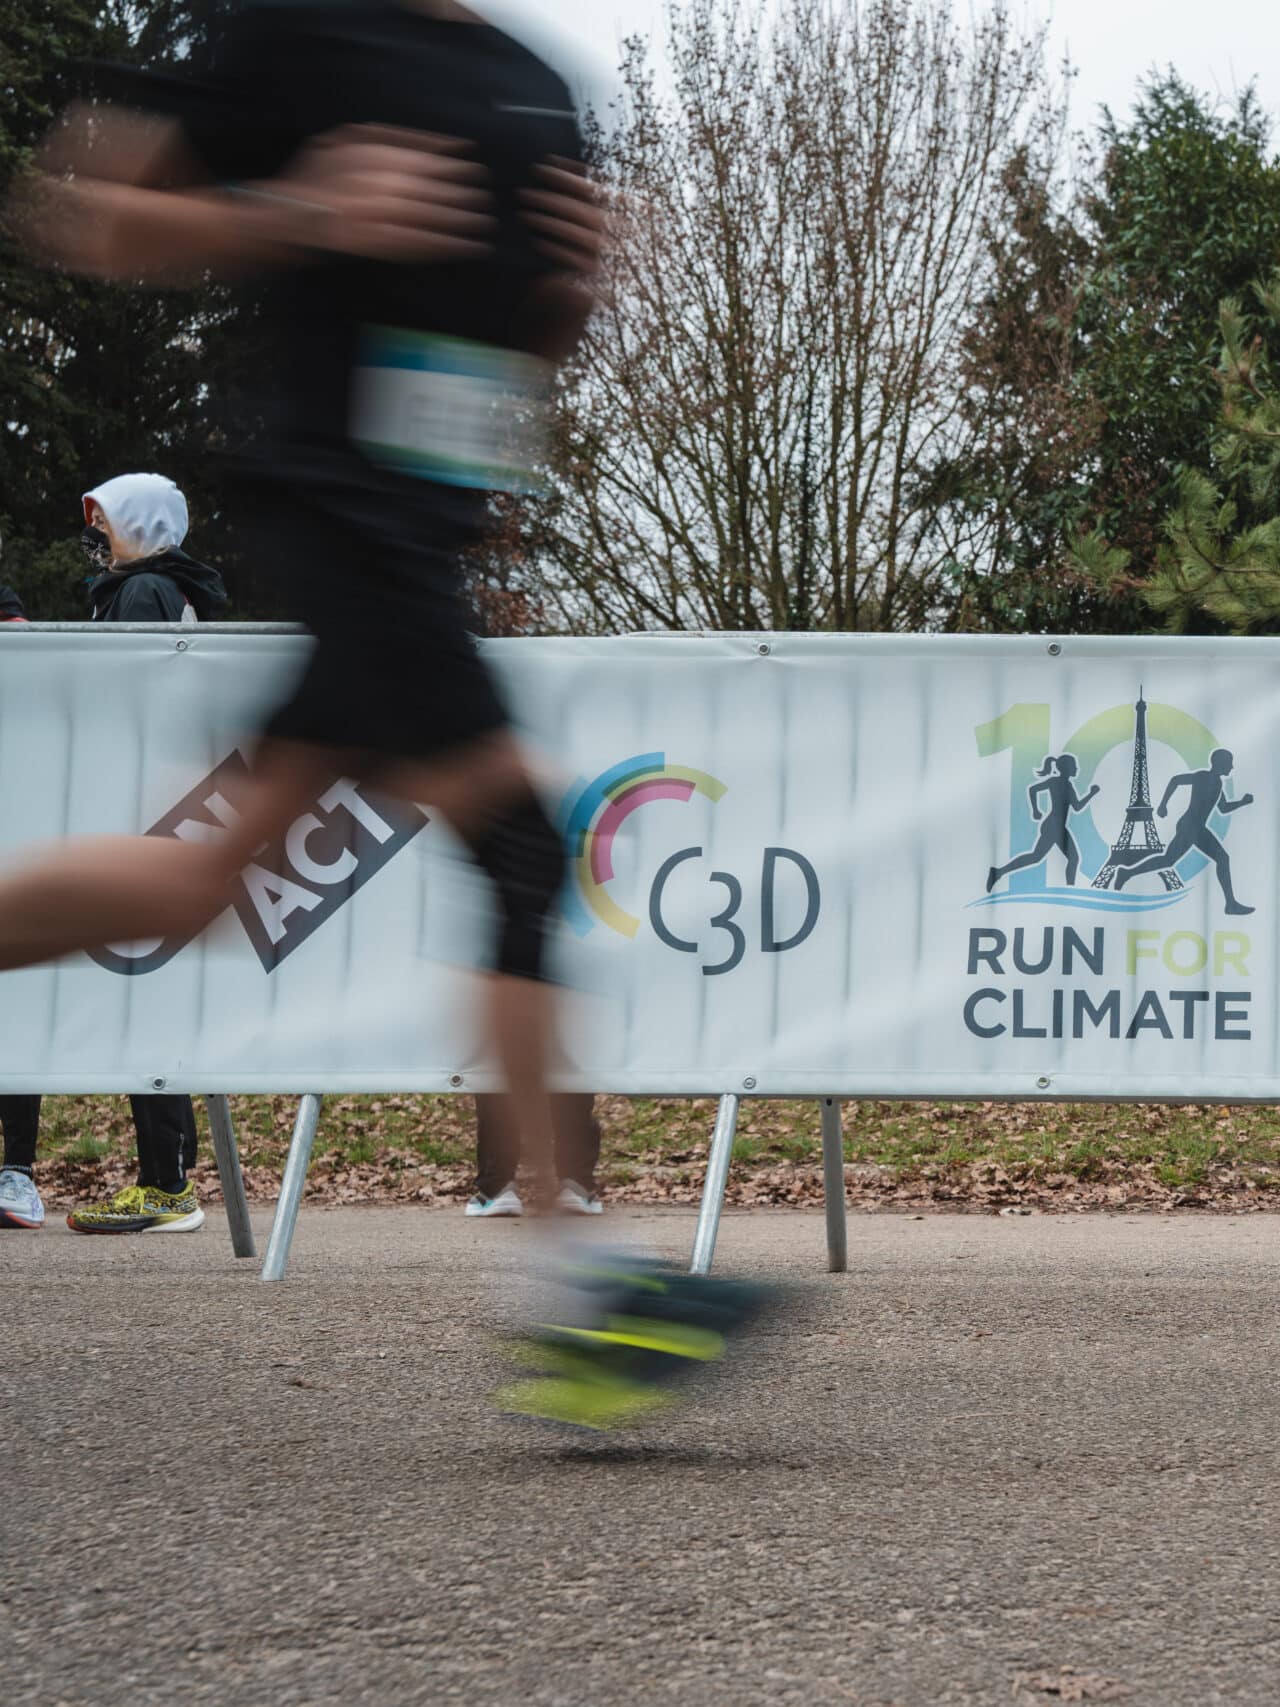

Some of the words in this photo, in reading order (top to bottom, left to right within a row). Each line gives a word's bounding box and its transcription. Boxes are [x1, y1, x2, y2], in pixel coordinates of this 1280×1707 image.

[239, 776, 396, 946] ACT
[649, 846, 821, 976] C3D
[967, 926, 1105, 976] RUN
[1125, 929, 1252, 977] FOR
[963, 987, 1252, 1040] CLIMATE
